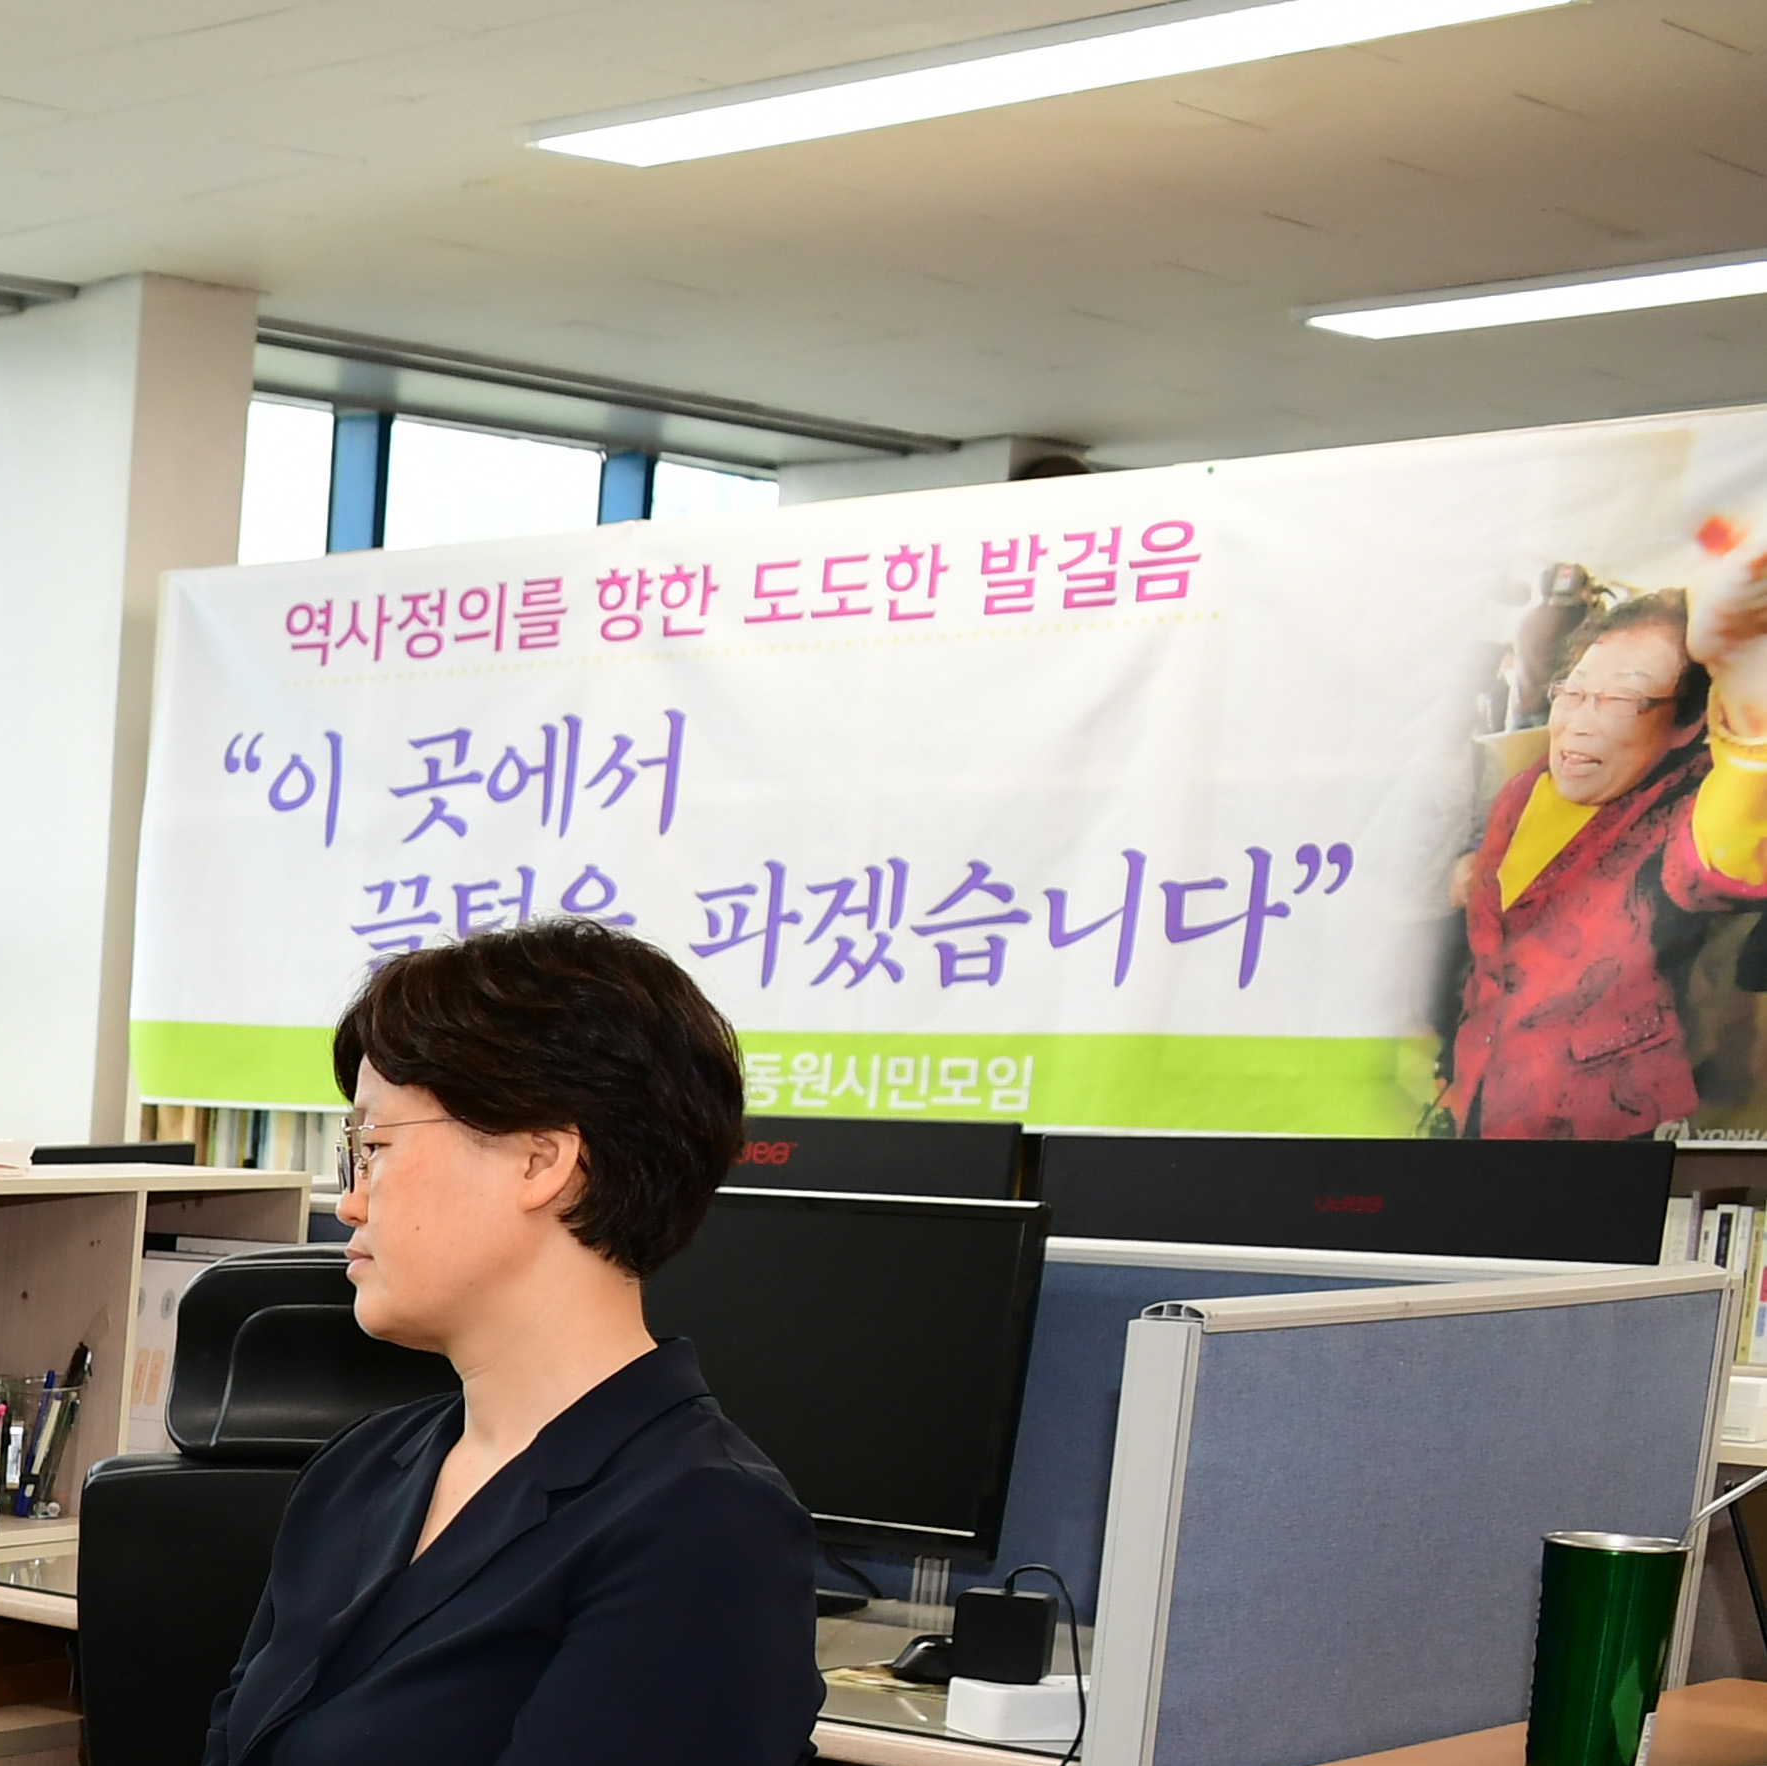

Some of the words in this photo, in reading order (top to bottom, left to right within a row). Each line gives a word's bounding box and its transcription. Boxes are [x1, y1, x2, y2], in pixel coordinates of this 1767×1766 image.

[285, 576, 568, 667] 역사정의를
[596, 563, 720, 643] 향한
[743, 542, 950, 624] 도도한
[980, 519, 1202, 616] 발걸음
[389, 708, 686, 844] 곳에서
[688, 841, 1354, 990] 파겠습니다”
